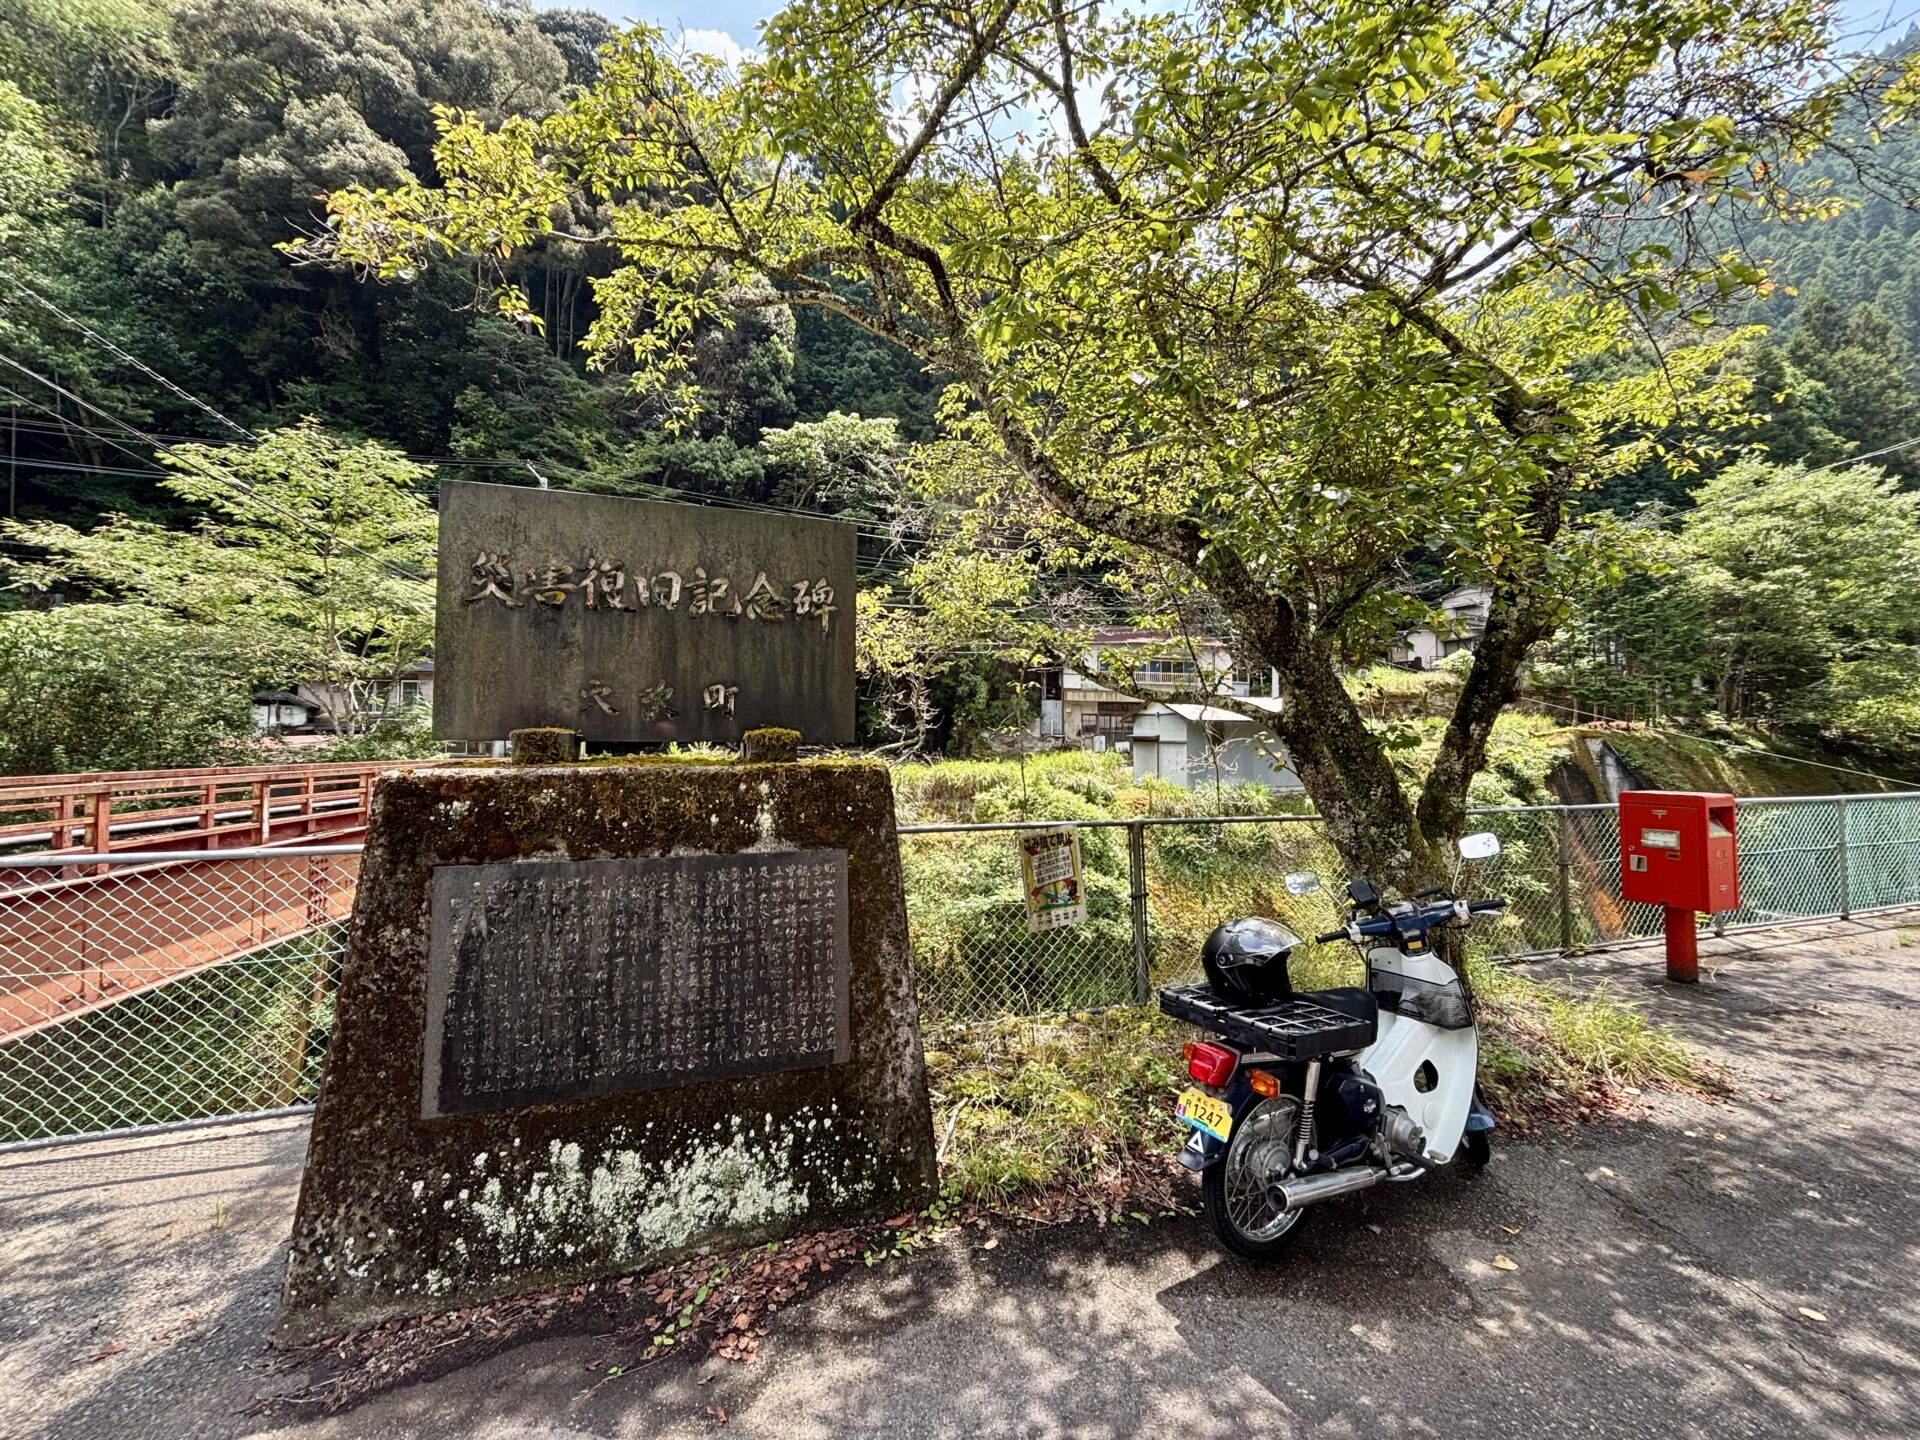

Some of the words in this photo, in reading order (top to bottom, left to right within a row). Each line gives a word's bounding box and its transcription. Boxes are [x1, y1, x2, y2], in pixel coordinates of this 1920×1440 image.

[462, 550, 839, 633] 災害復旧記念碑
[1186, 1098, 1192, 1107] R
[1194, 1103, 1223, 1127] 1247
